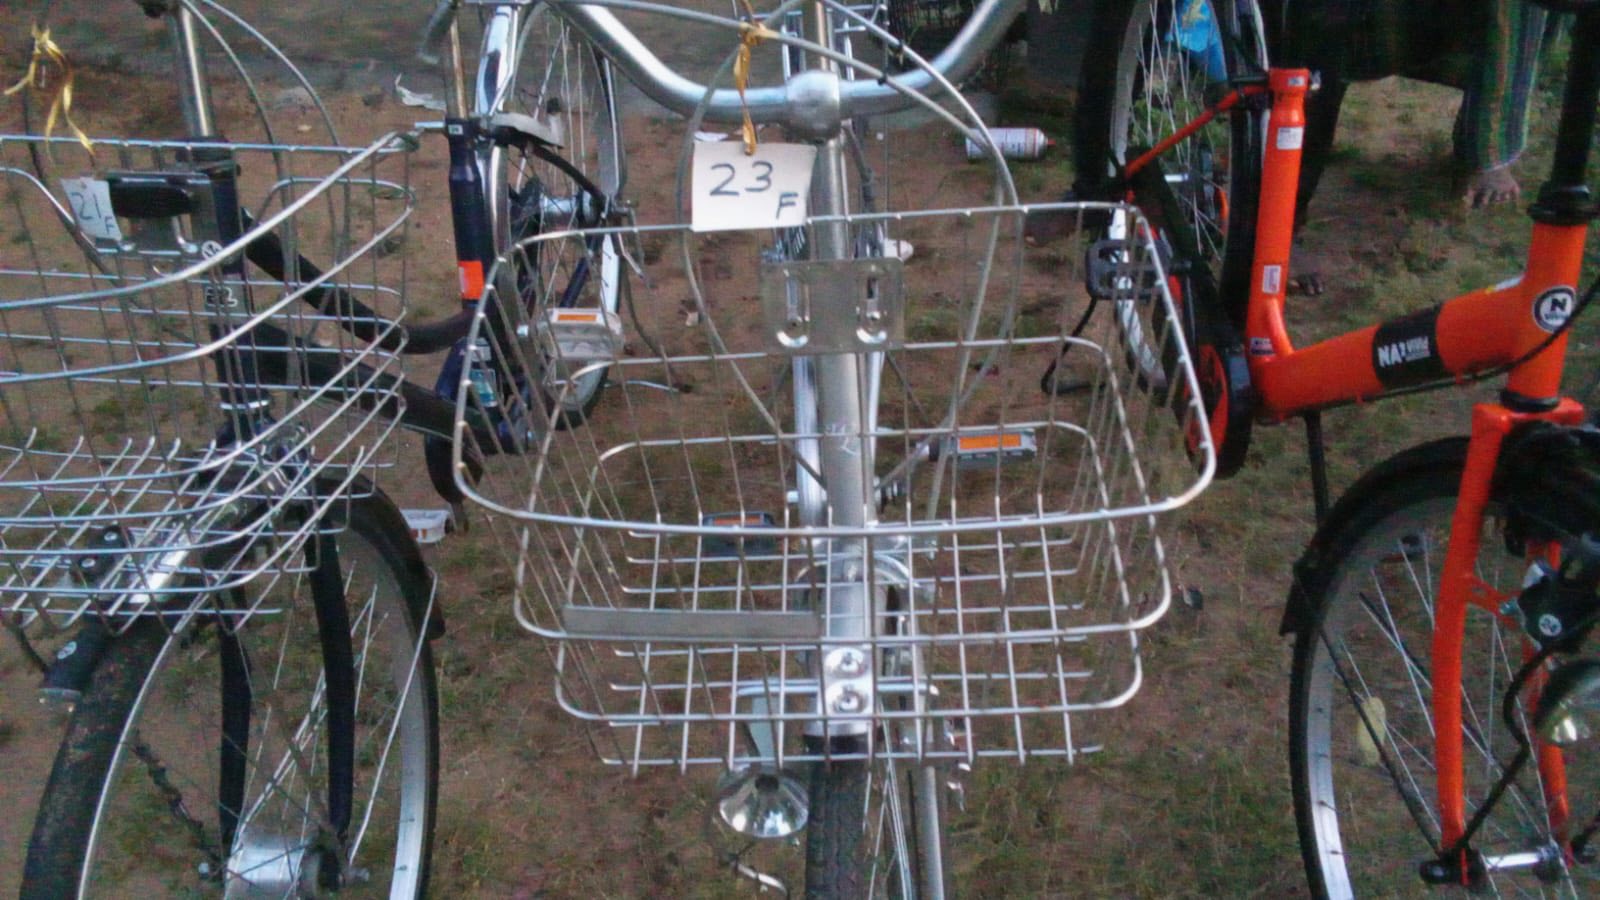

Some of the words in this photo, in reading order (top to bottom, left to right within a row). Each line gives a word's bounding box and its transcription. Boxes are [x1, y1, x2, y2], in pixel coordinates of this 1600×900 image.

[709, 161, 773, 196] 23
[70, 192, 102, 219] 21
[776, 192, 799, 219] F
[104, 216, 115, 235] F
